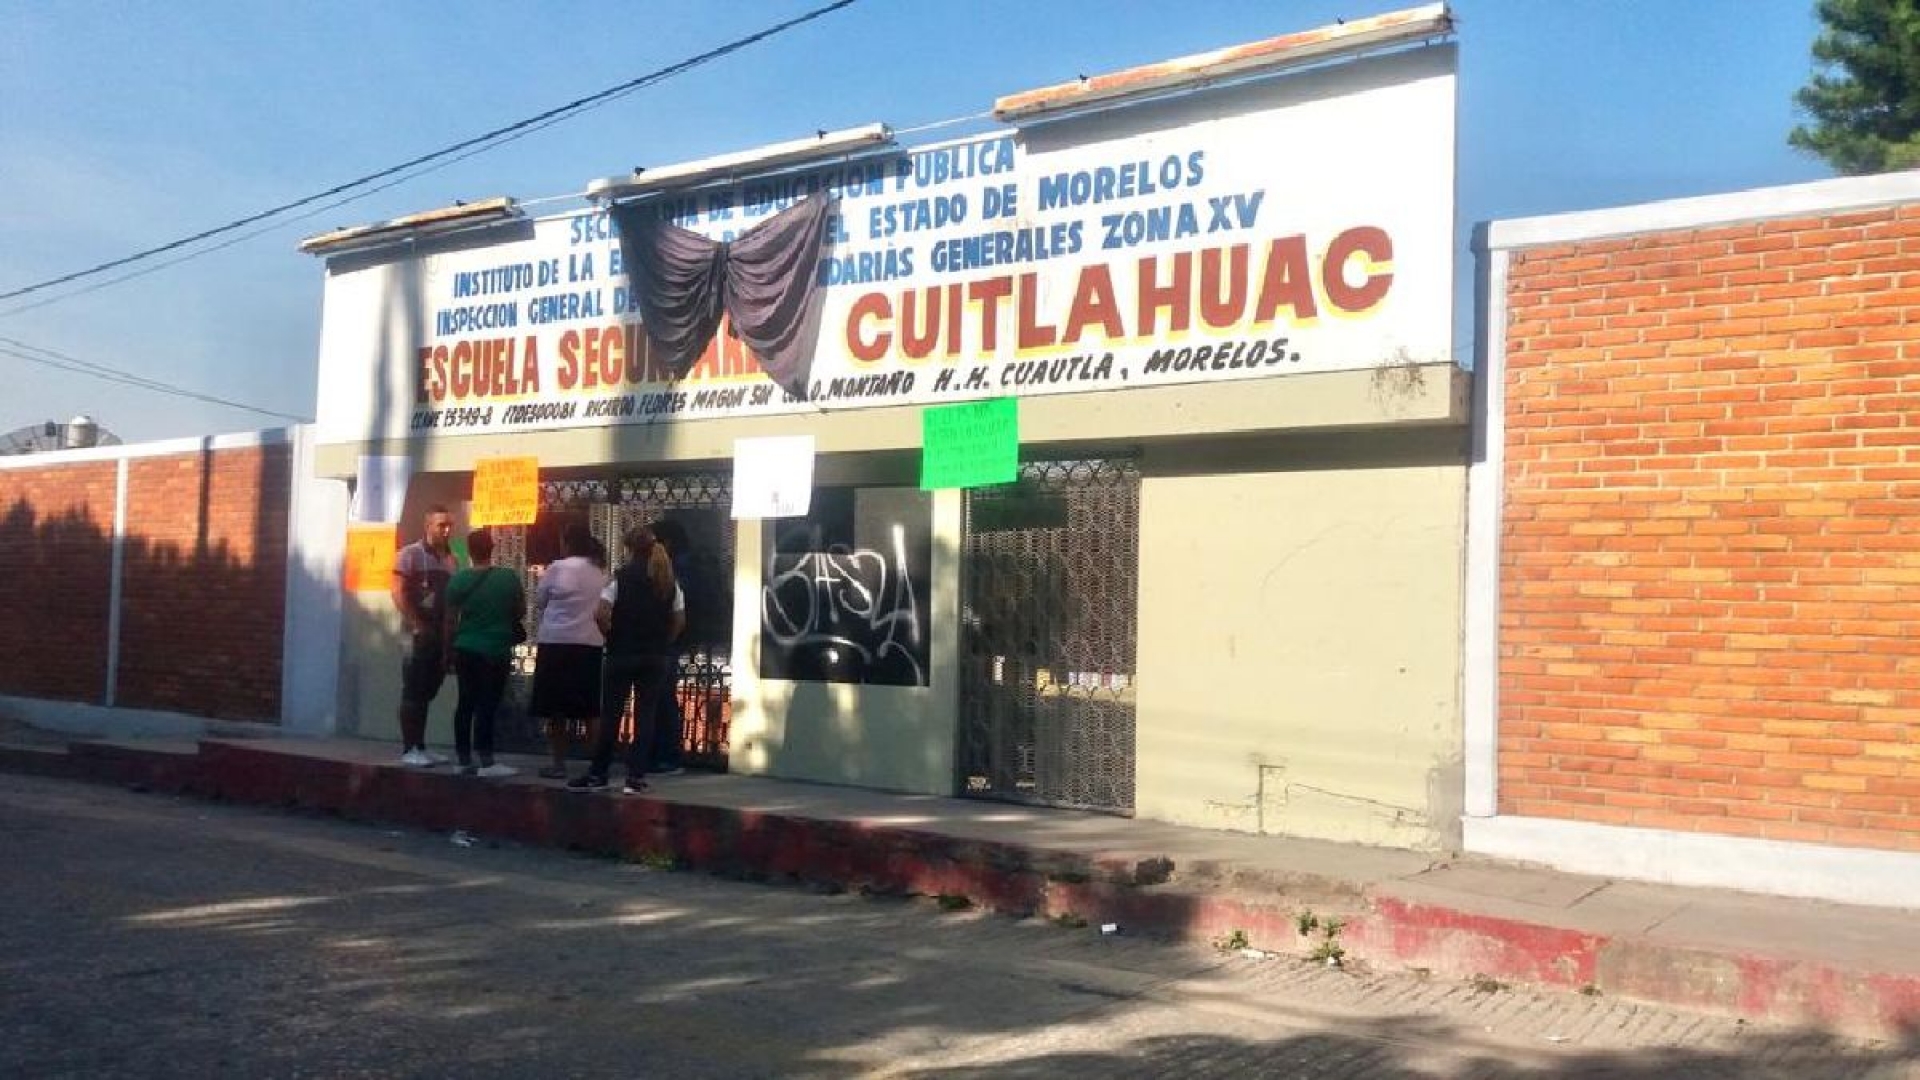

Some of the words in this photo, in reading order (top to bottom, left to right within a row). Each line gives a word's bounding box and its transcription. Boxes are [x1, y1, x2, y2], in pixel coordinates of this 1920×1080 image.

[454, 263, 533, 299] INSTITUTO
[539, 259, 560, 287] DE
[569, 252, 594, 283] LA
[822, 213, 850, 245] EL
[869, 193, 968, 239] ESTADO
[982, 183, 1018, 220] DE
[1037, 150, 1206, 212] MORELOS
[895, 139, 1016, 192] PUBLICA
[417, 335, 540, 404] ESCUELA
[845, 225, 1395, 362] CUITLAHUAC
[436, 302, 518, 336] INSPECCION
[527, 288, 604, 325] GENERAL
[930, 220, 1084, 274] GENERALES
[1101, 202, 1199, 250] ZONA
[1207, 189, 1266, 234] XV
[637, 391, 688, 415] FLORES
